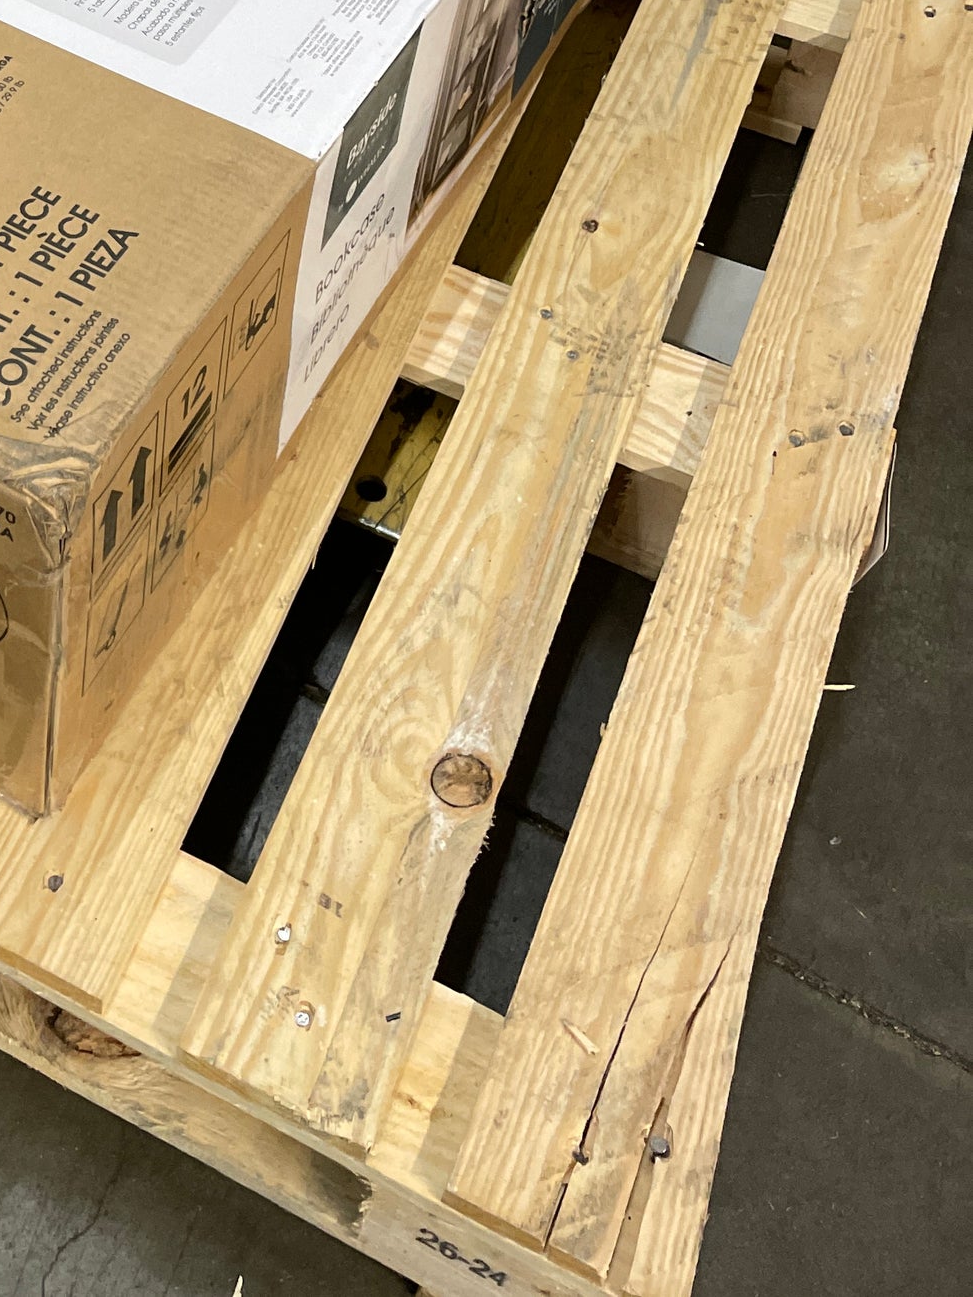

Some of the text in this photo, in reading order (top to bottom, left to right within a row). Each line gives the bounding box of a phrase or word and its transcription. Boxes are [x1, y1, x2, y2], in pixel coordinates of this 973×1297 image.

[28, 203, 100, 272] PIÈCE
[68, 228, 140, 291] PIEZA
[315, 193, 384, 305] Bookcase
[14, 270, 44, 287] 1
[54, 290, 84, 307] 1
[310, 206, 395, 345] Bibliothèque
[9, 309, 102, 423] See attached instructions
[26, 316, 119, 430] Voir les instructions jointes
[66, 361, 109, 410] instructivo
[104, 332, 131, 363] anexo
[303, 302, 350, 383] Librero
[181, 365, 207, 420] 12
[415, 1227, 507, 1287] 26-24
